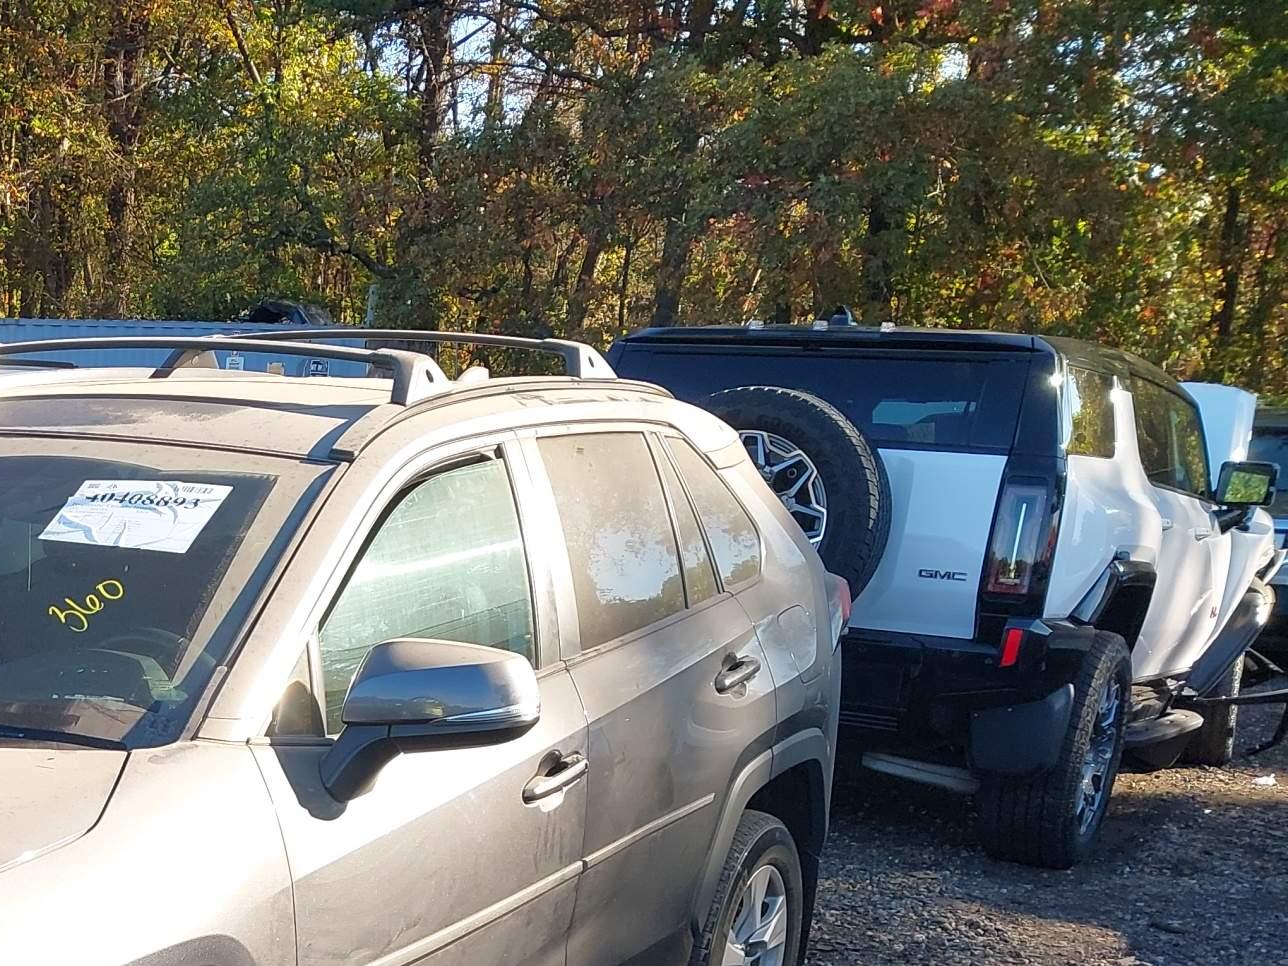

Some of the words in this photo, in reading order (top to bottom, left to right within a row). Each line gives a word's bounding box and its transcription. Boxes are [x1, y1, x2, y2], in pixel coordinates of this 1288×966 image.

[86, 491, 201, 510] 40408893
[918, 568, 968, 582] GMC
[48, 579, 124, 632] 360
